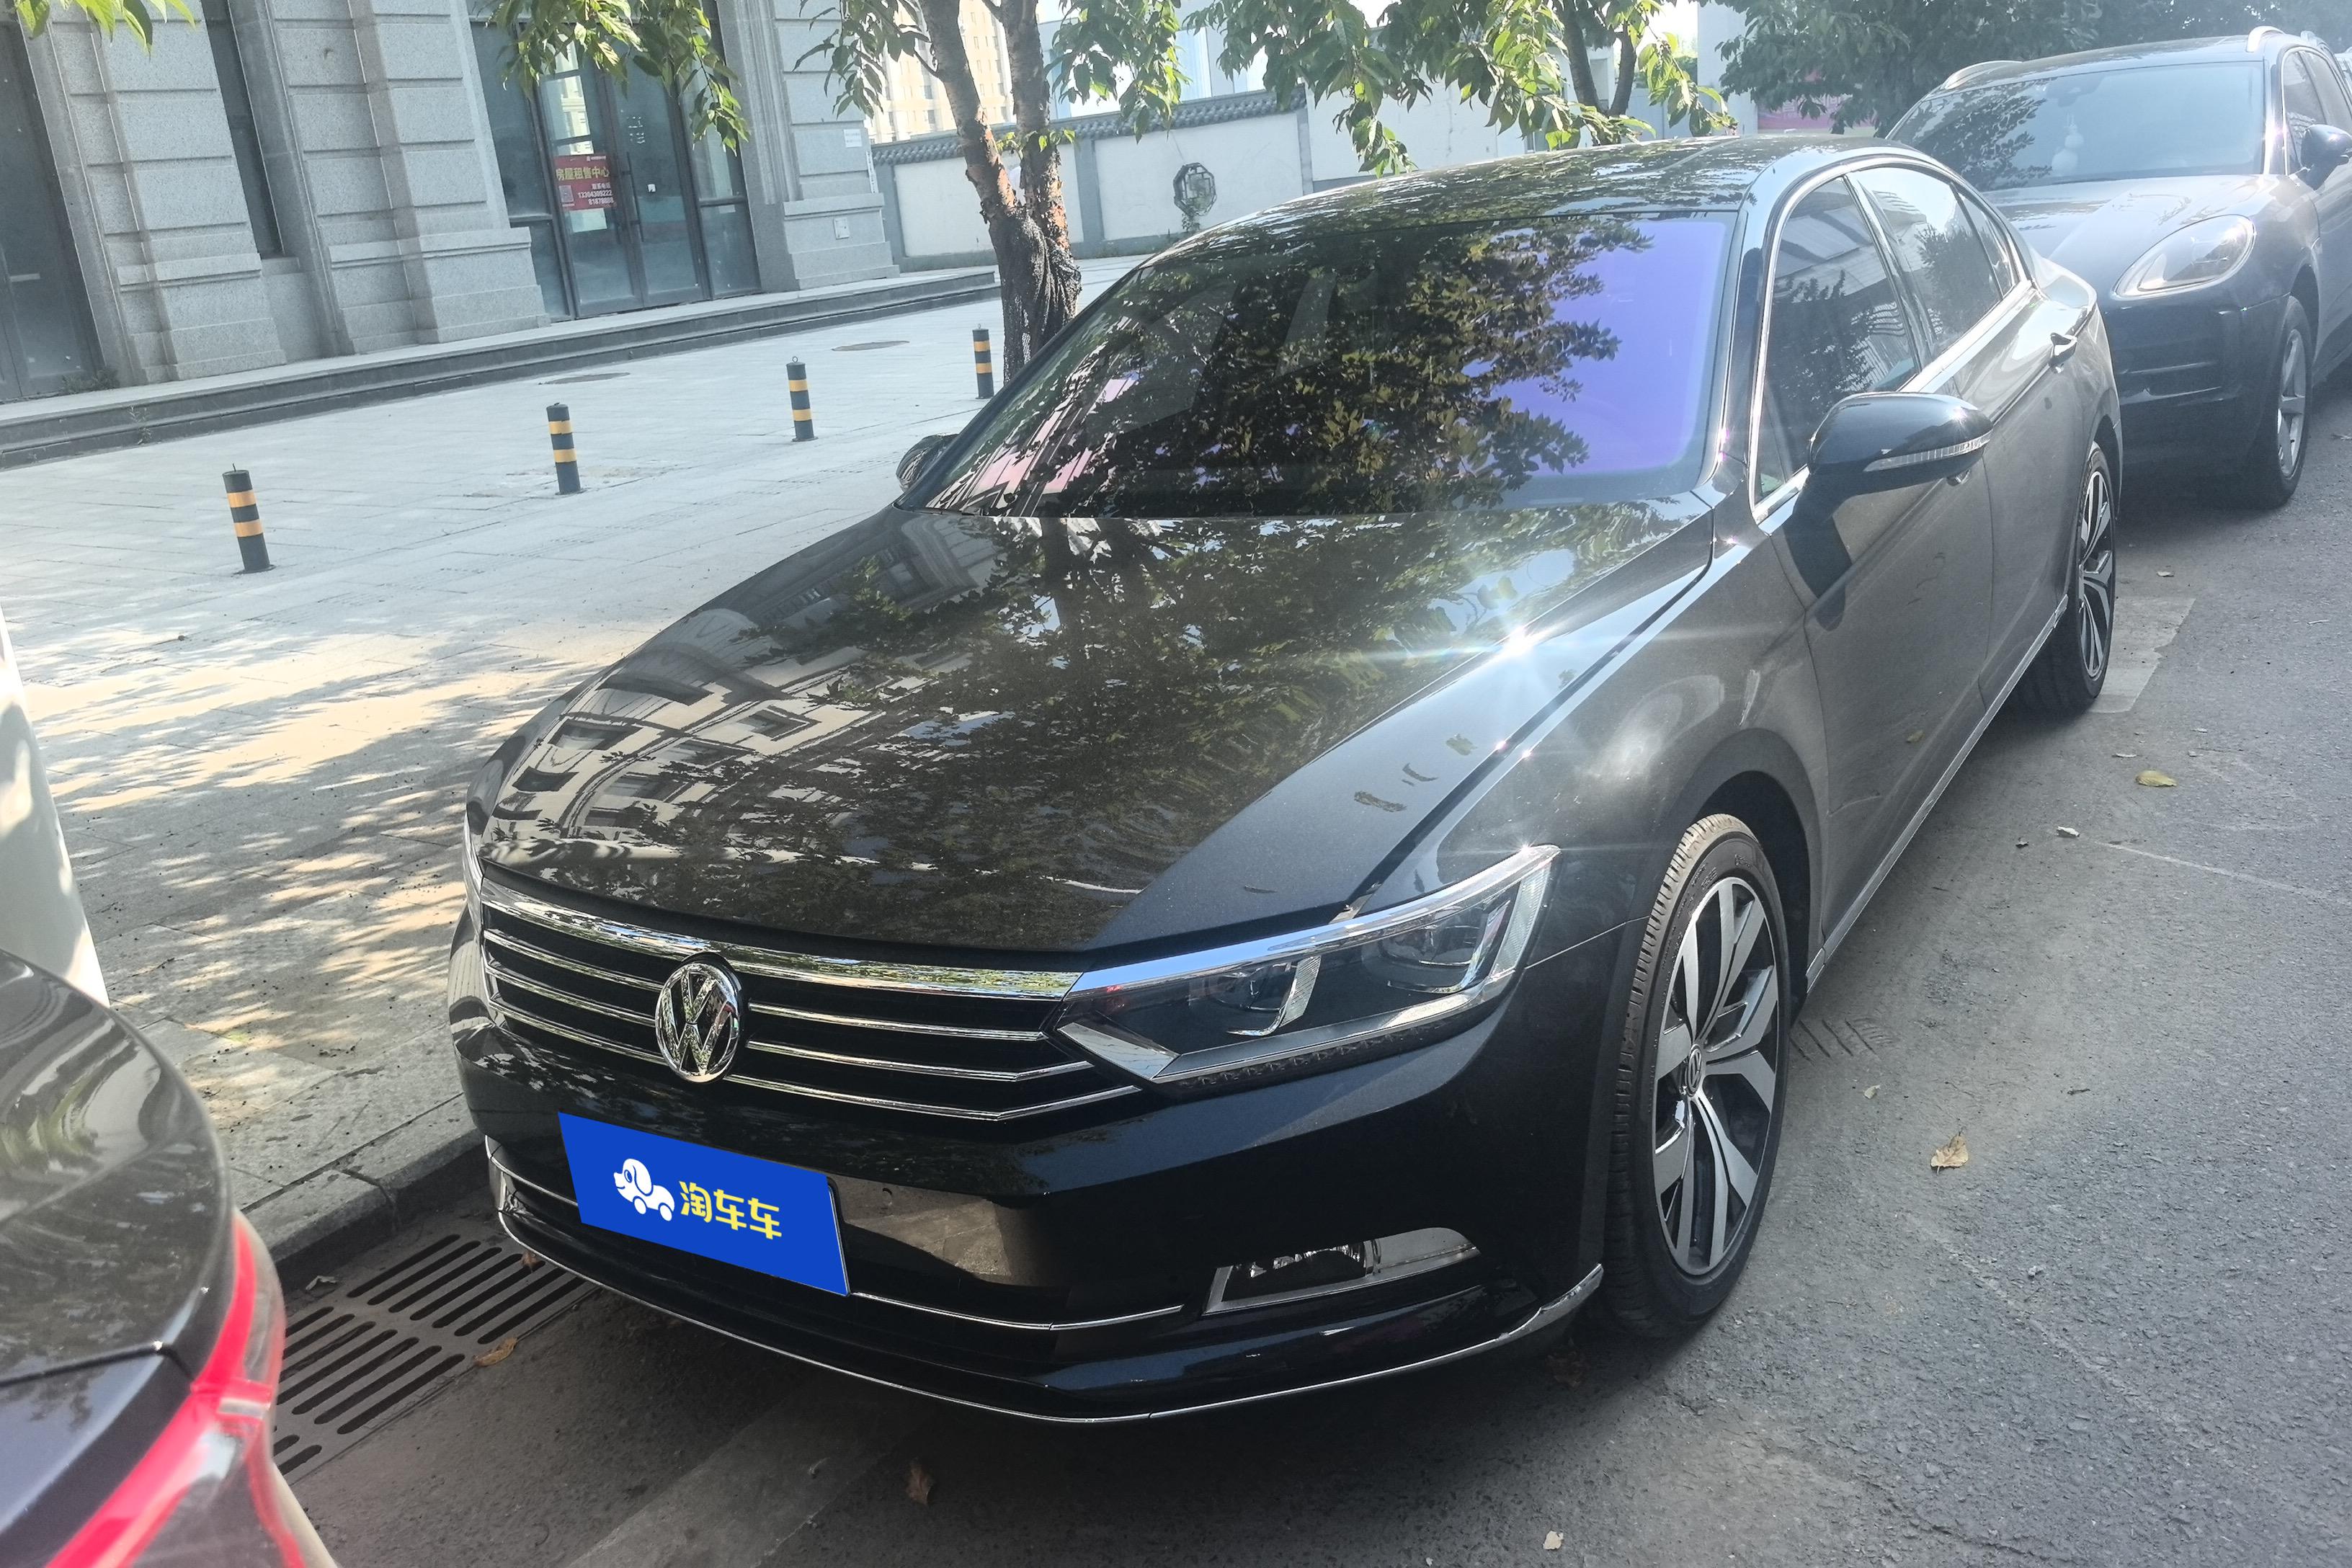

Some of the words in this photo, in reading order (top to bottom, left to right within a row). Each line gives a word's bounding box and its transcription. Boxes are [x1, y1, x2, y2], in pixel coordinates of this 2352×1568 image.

[556, 166, 610, 181] 房屋租售中心
